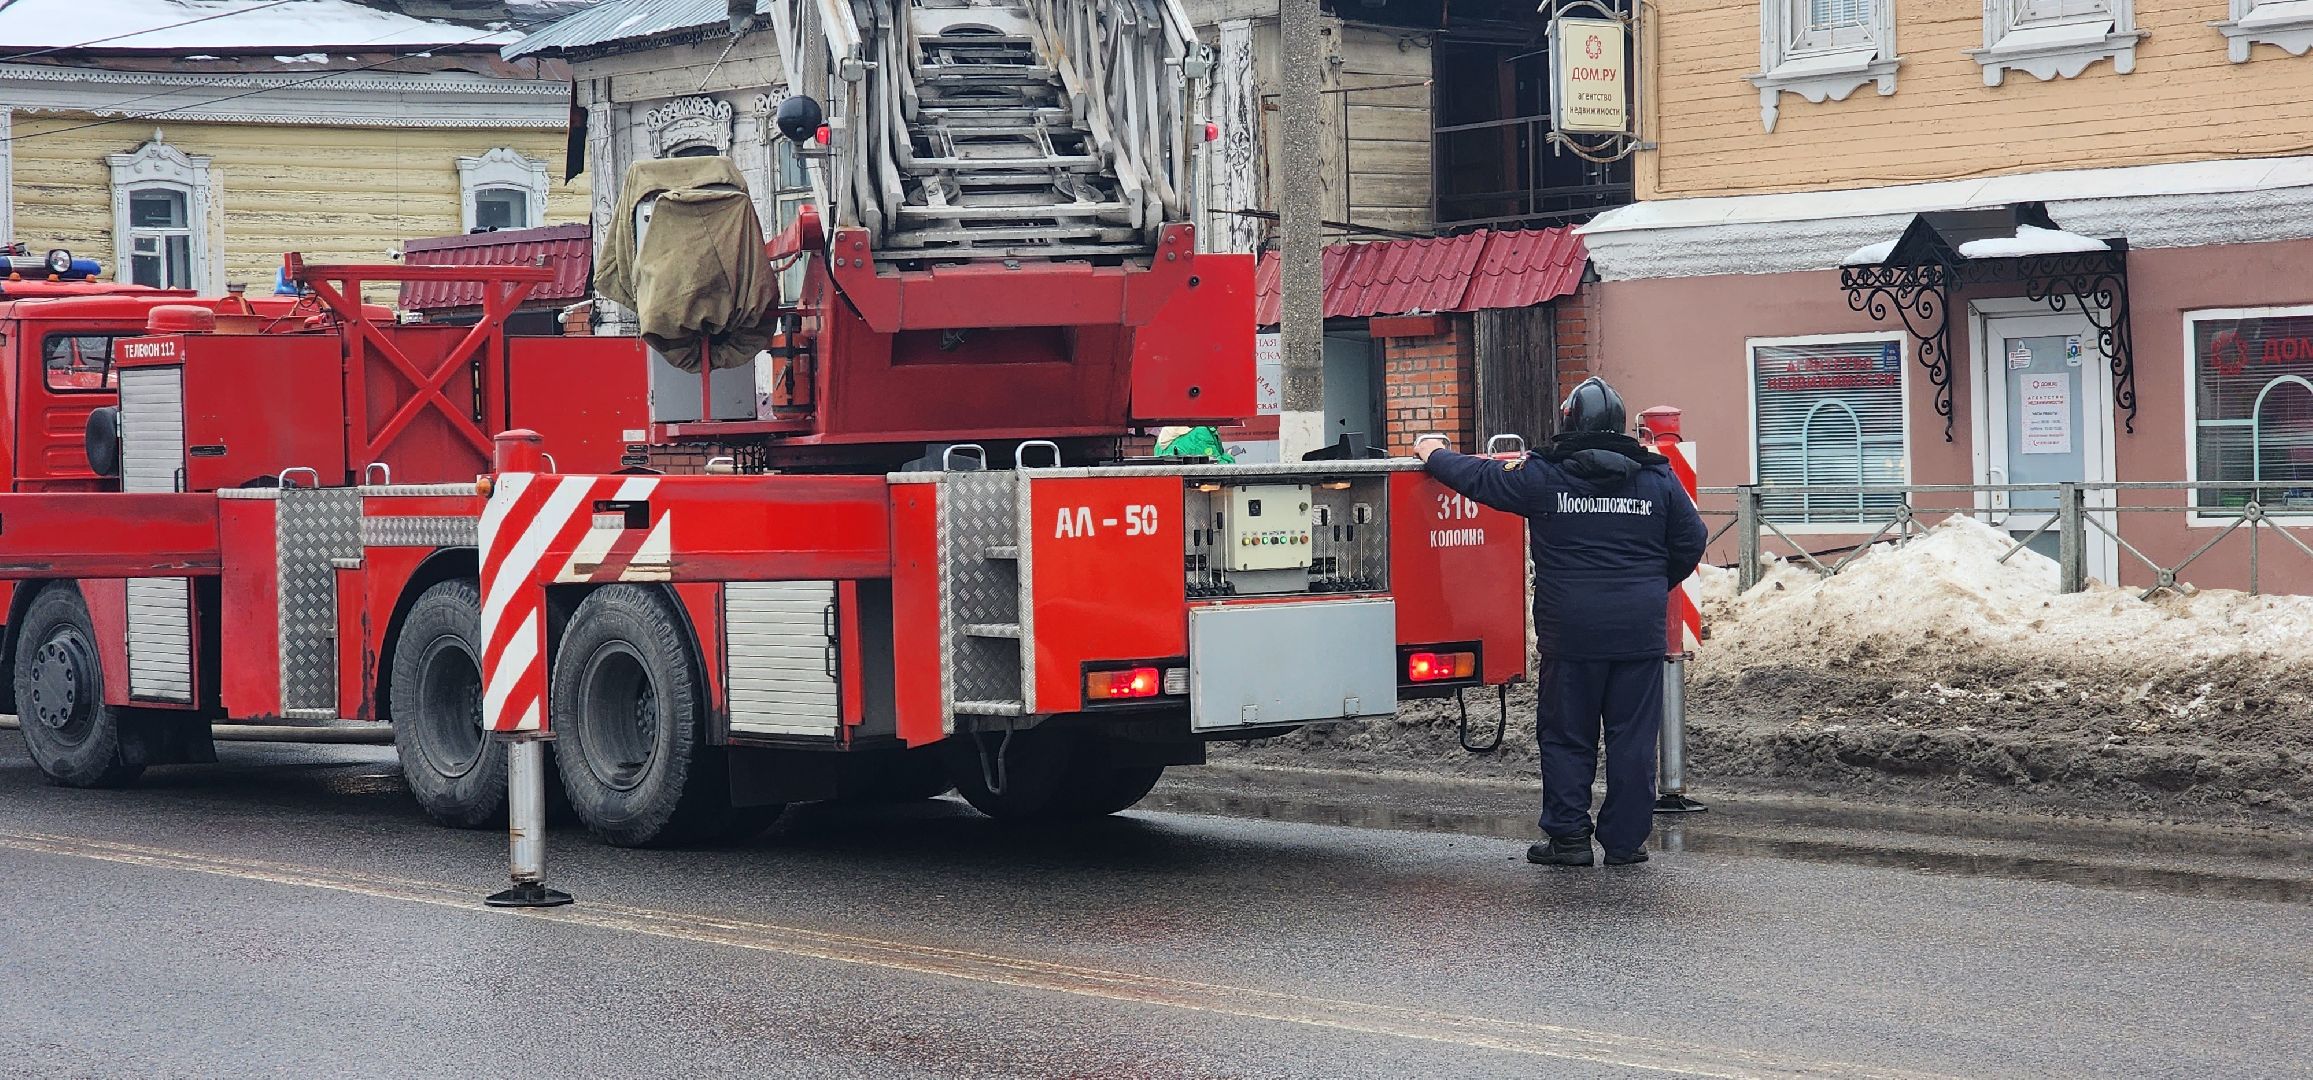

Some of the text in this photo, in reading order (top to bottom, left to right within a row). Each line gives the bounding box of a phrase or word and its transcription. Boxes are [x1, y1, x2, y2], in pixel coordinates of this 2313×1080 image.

[1572, 67, 1617, 82] ДОМ.РУ
[1577, 93, 1612, 101] агентство
[1569, 106, 1620, 116] недвижимости
[124, 341, 175, 358] ТЕЛЕФОН 112
[1437, 492, 1479, 520] 316
[1055, 506, 1095, 539] АЛ
[1126, 504, 1158, 536] 50
[1430, 528, 1485, 548] КОЛОМНА
